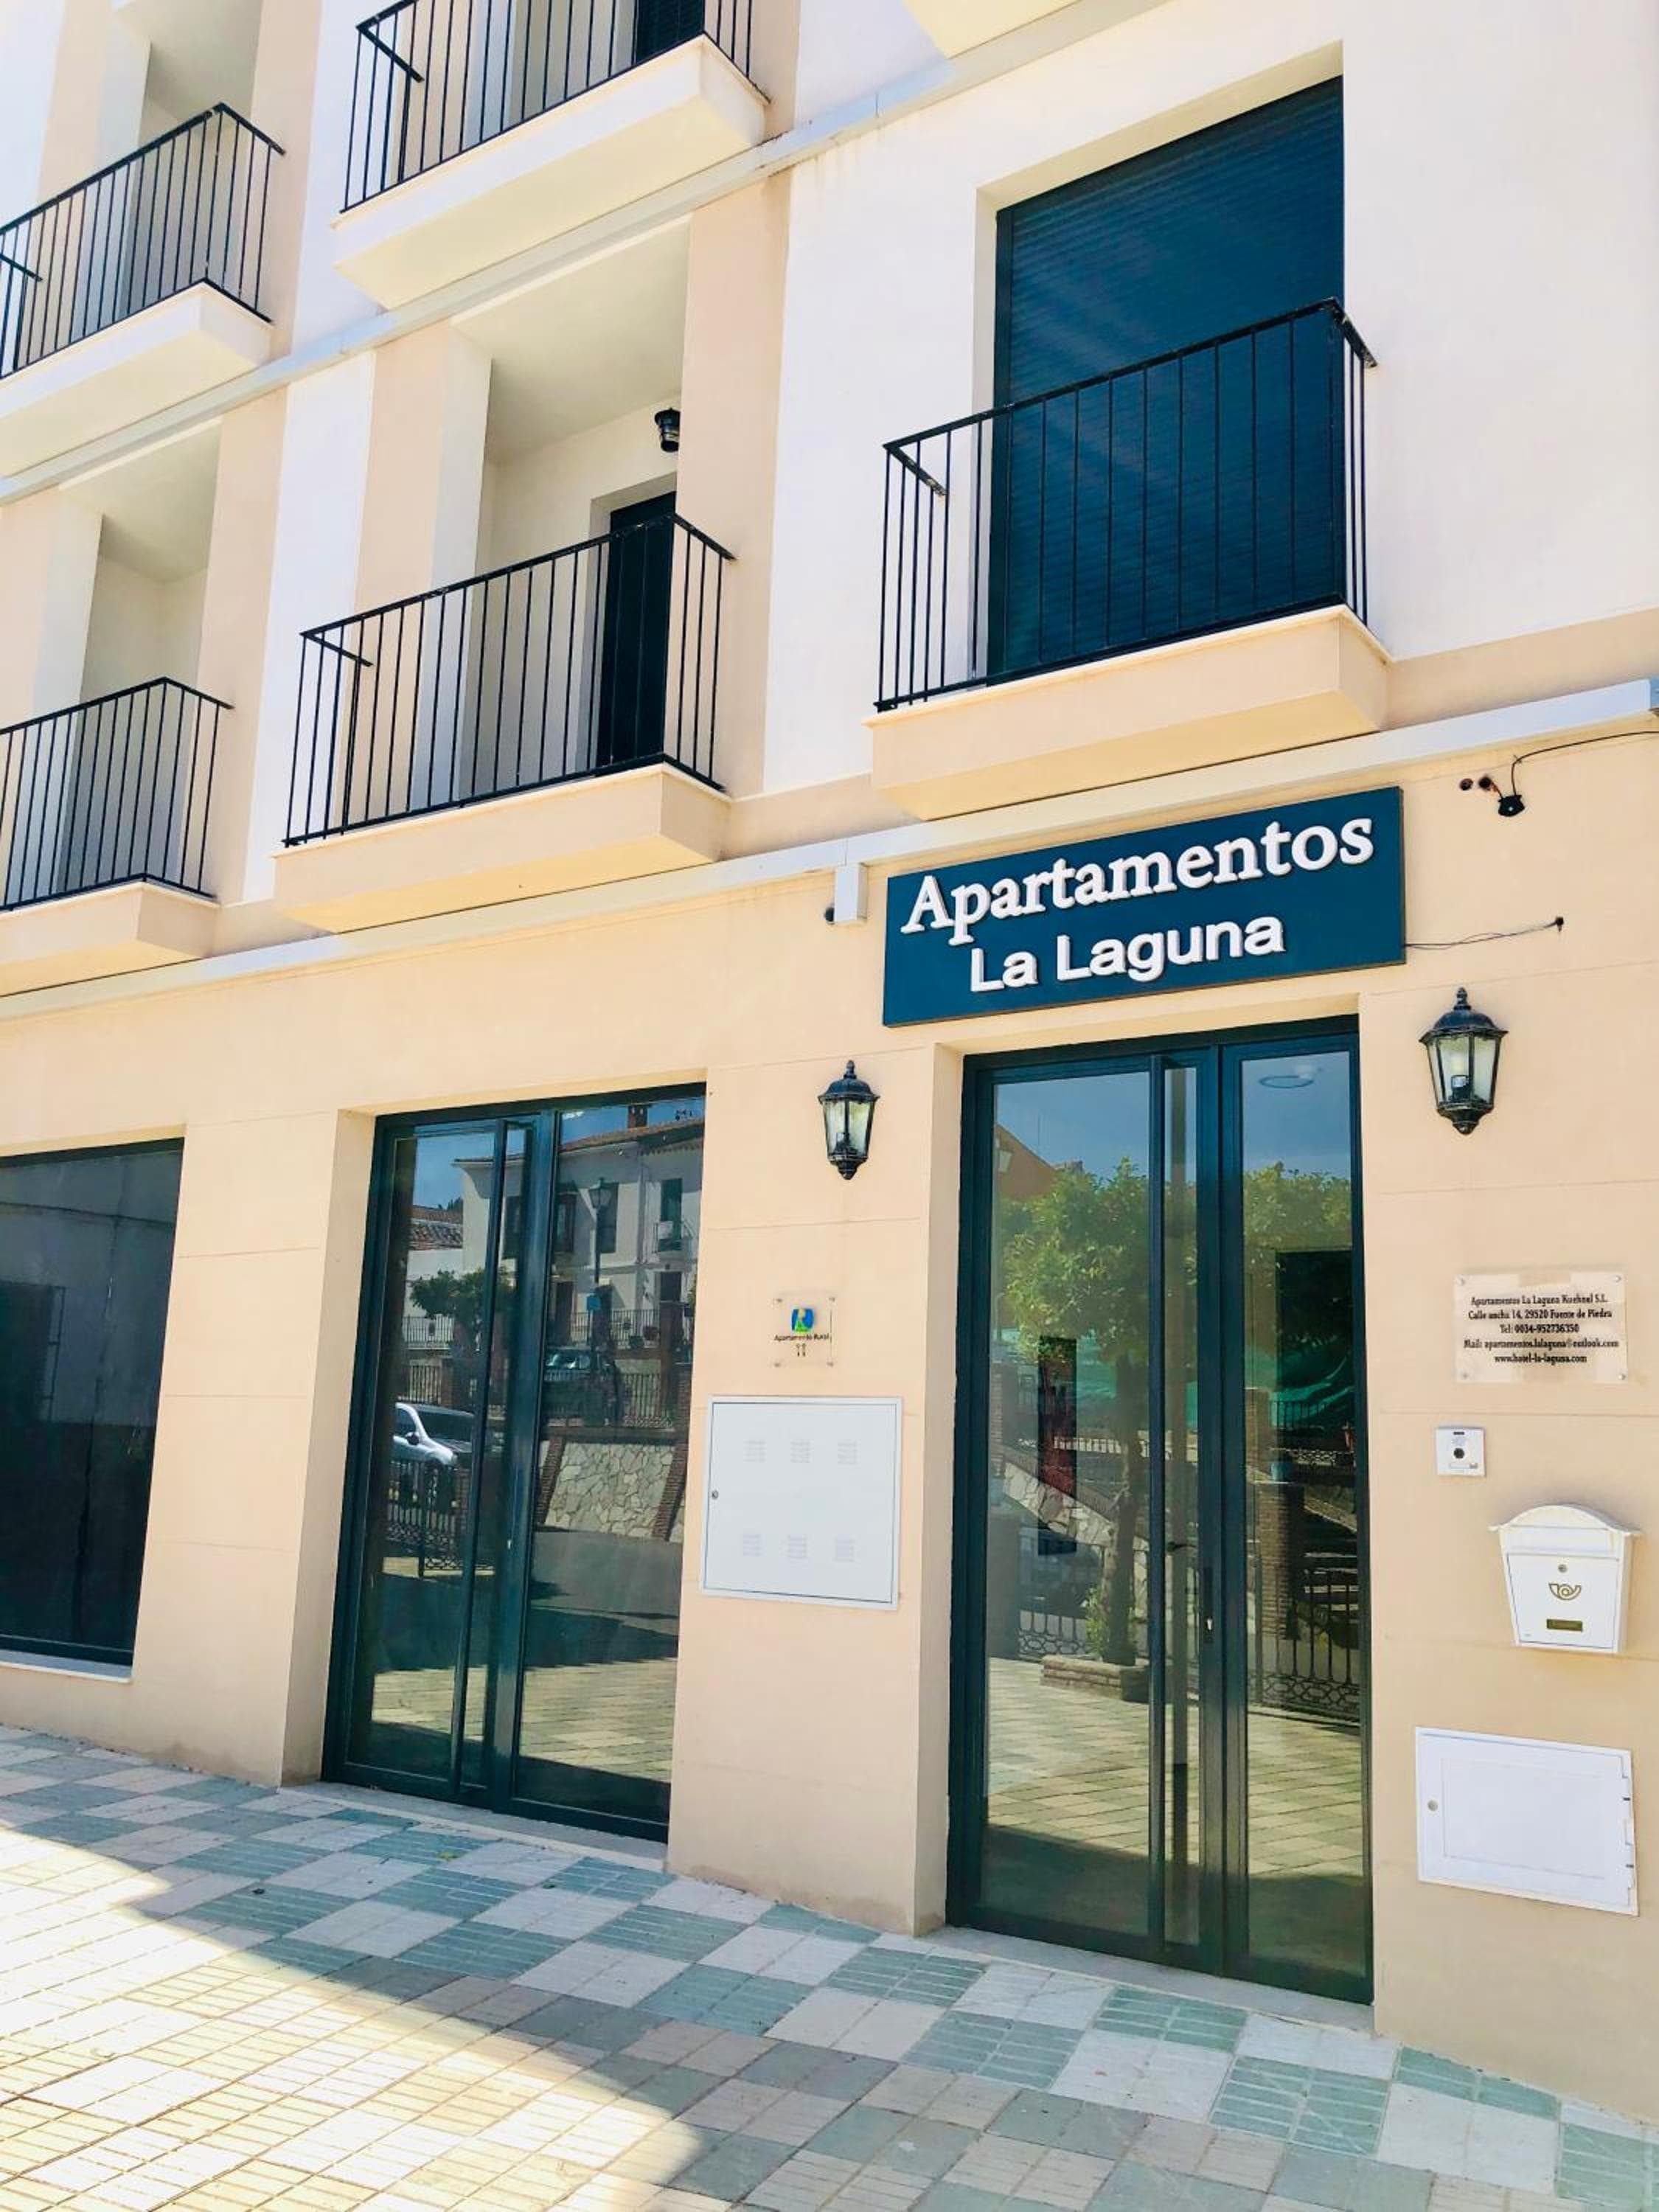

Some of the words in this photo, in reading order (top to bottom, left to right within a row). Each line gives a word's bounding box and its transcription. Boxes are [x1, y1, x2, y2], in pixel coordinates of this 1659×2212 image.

[900, 817, 1374, 946] Apartamentos
[970, 947, 1038, 993] La
[1056, 915, 1285, 982] Laguna
[1468, 1310, 1486, 1320] Calle
[1524, 1309, 1549, 1319] 29520
[1550, 1310, 1575, 1319] Fuente
[1576, 1309, 1586, 1318] de
[1587, 1308, 1613, 1318] Piedra
[1471, 1296, 1520, 1307] Apartamentos
[1522, 1295, 1531, 1304] La
[1532, 1295, 1560, 1307] Laguna
